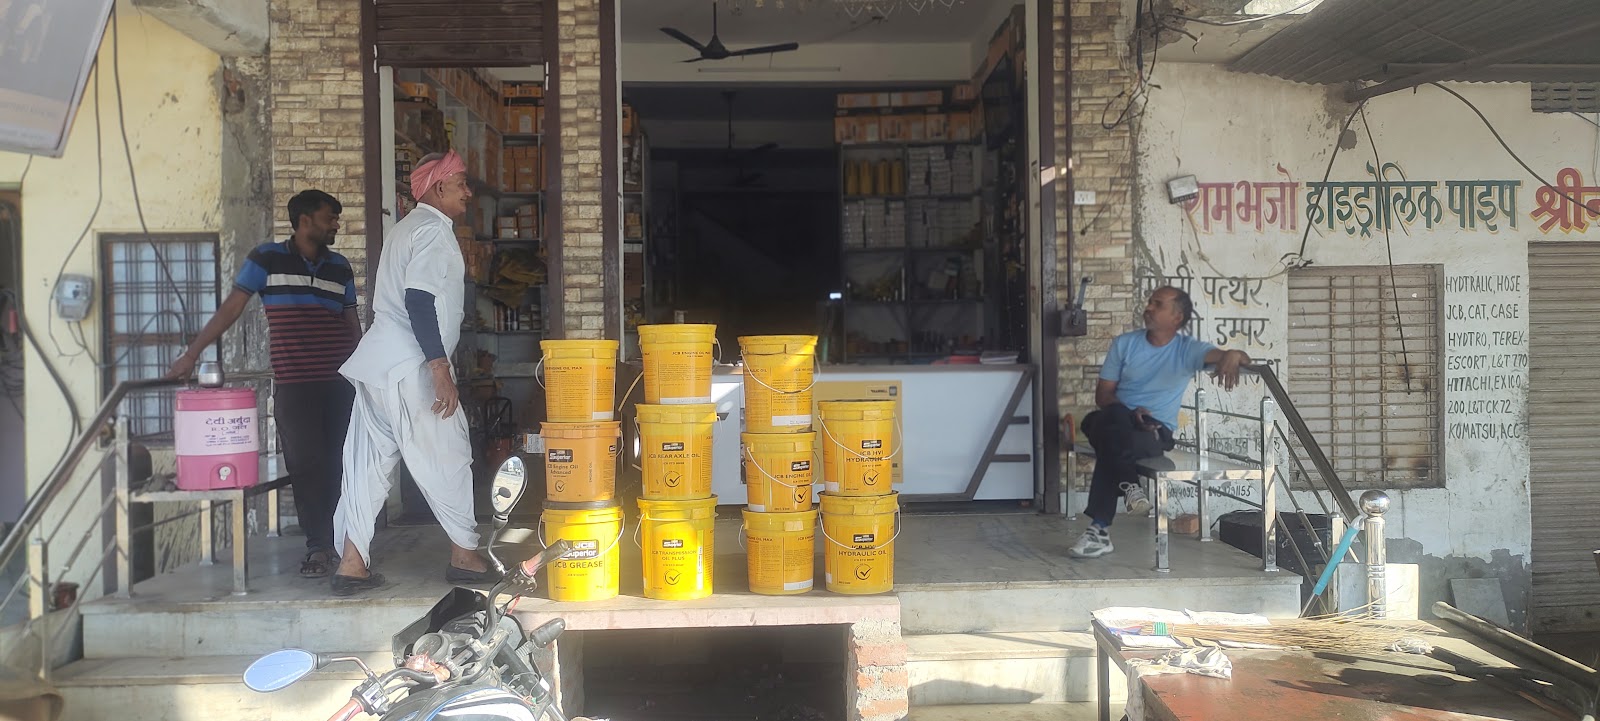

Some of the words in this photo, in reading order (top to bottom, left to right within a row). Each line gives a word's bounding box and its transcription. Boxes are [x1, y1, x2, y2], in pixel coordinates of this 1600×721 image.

[1445, 179, 1521, 232] पाइप
[1496, 275, 1520, 292] HOSE
[1446, 304, 1466, 323] JCB,
[1468, 304, 1488, 321] CAT,
[1490, 303, 1519, 319] CASE
[1491, 354, 1510, 368] L&T
[1512, 353, 1528, 368] 770
[1448, 422, 1499, 442] KOMATSU,
[1500, 422, 1520, 440] ACC
[550, 452, 572, 461] Superior
[569, 561, 603, 569] GREASE
